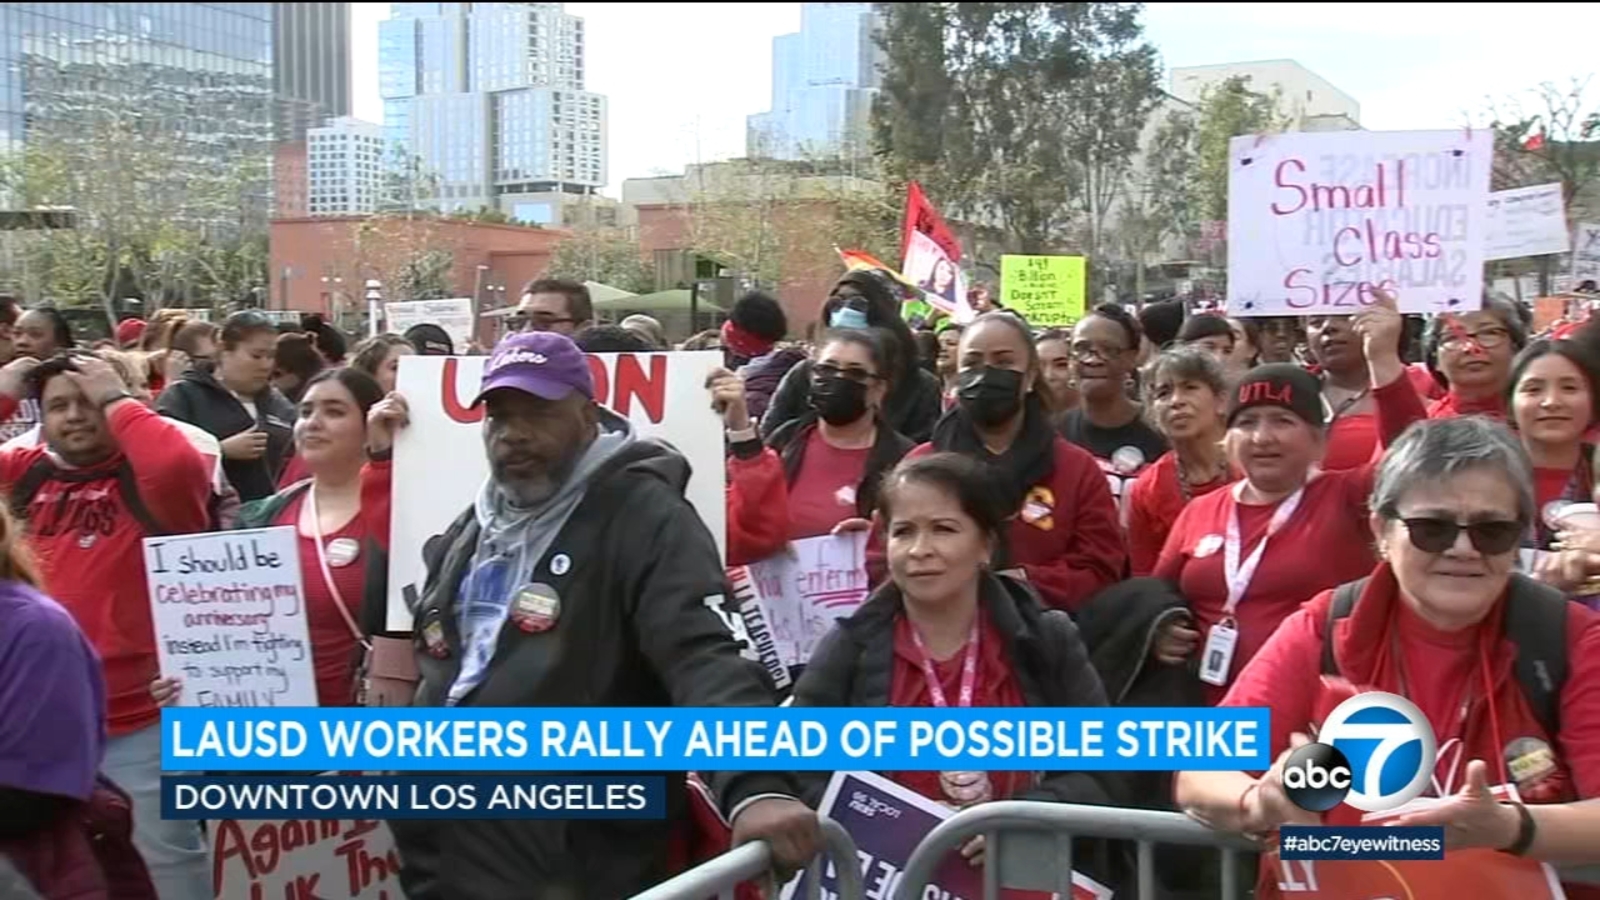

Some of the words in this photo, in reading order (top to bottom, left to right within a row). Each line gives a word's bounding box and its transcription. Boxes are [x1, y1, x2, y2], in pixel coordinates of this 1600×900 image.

[1271, 159, 1404, 215] Small
[1284, 269, 1398, 308] Sizes
[1239, 381, 1293, 404] UTLA
[148, 542, 170, 573] I
[178, 541, 248, 574] should
[252, 539, 283, 568] be
[273, 584, 300, 616] my
[164, 634, 221, 655] instead
[252, 632, 305, 663] fighting
[182, 662, 202, 678] to
[209, 664, 262, 685] support
[265, 666, 289, 694] my
